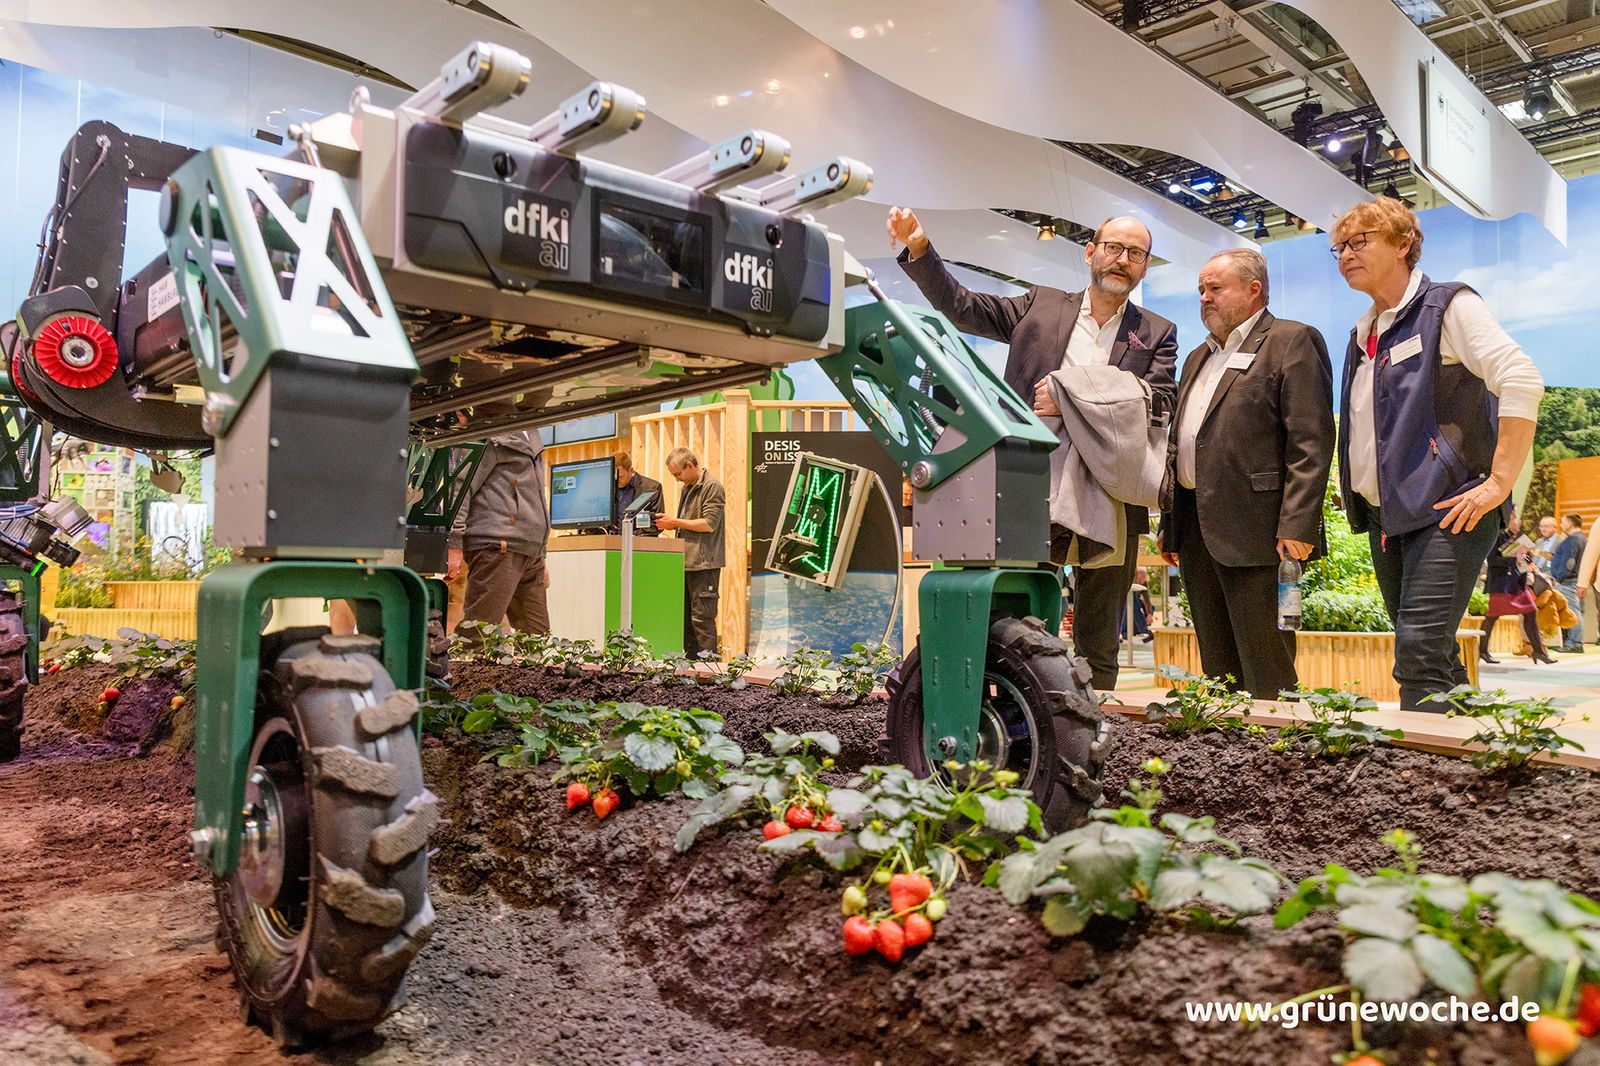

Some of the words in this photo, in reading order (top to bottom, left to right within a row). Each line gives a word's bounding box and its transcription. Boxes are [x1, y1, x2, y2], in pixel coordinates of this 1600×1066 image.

[504, 199, 569, 244] dfki
[724, 251, 774, 290] dfki
[764, 440, 801, 451] DESIS
[764, 452, 782, 461] ON
